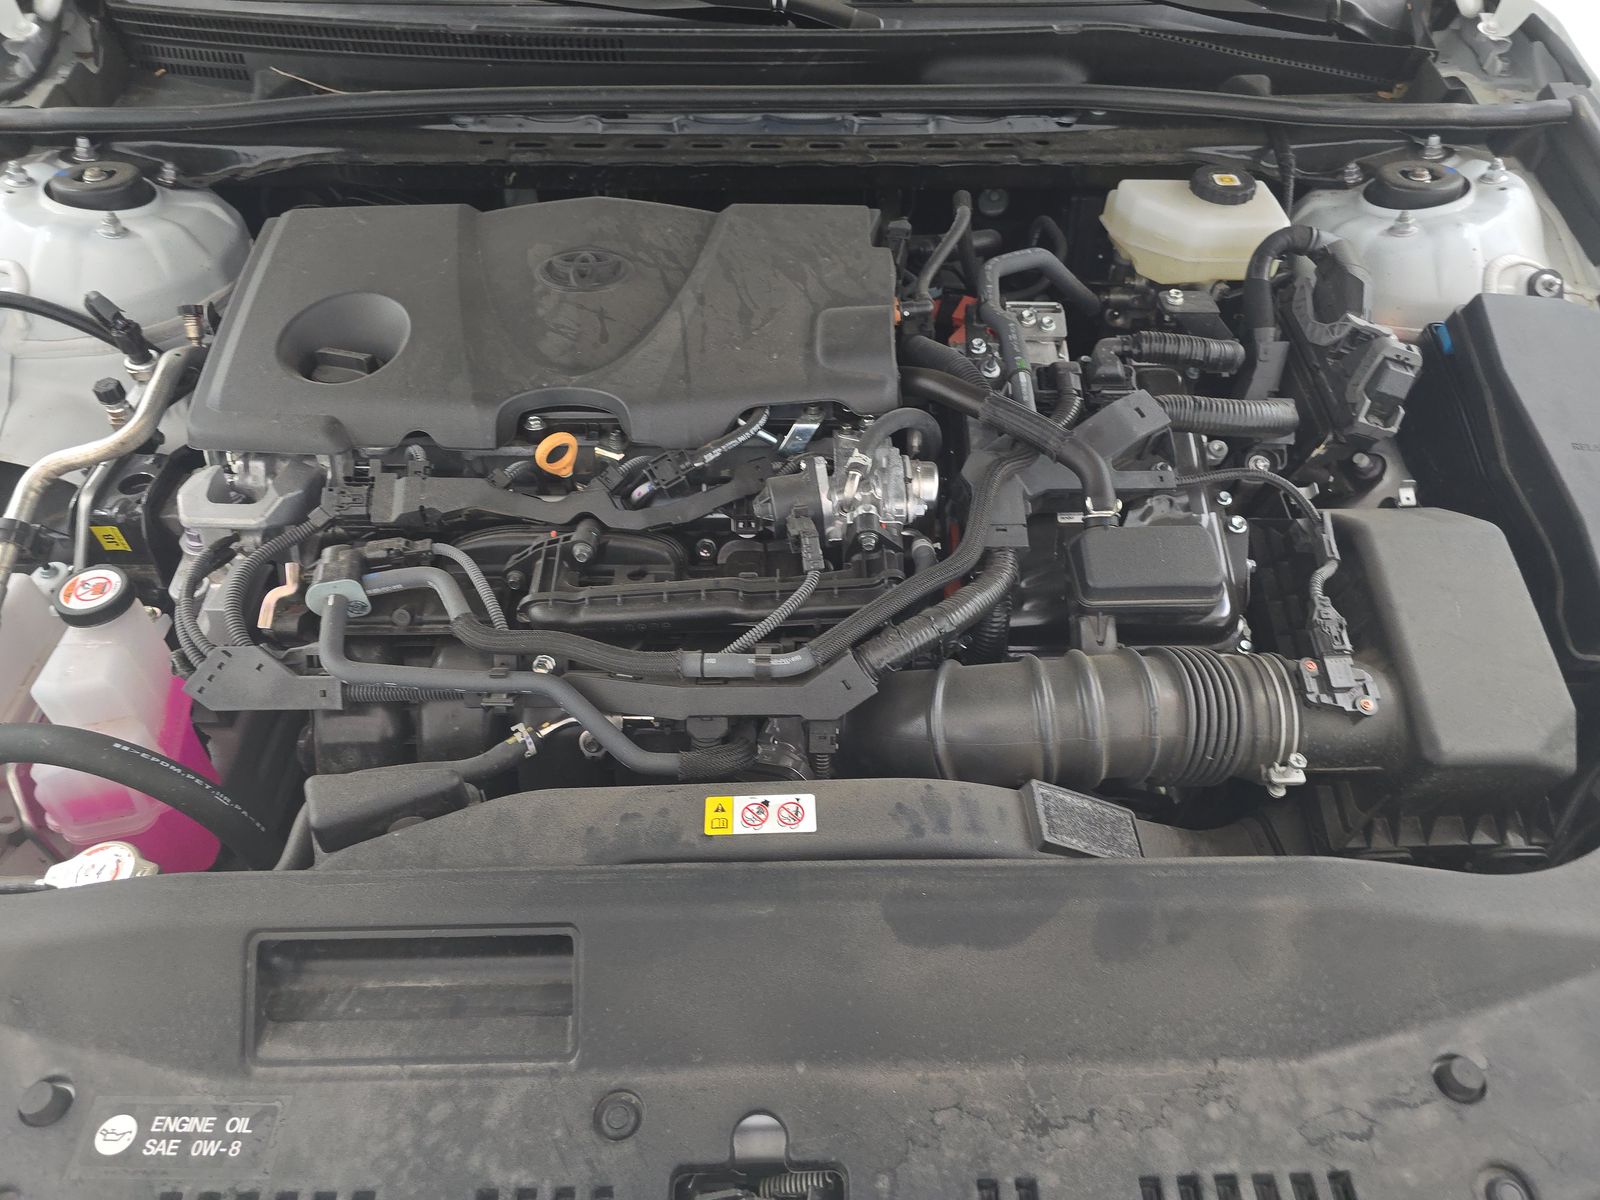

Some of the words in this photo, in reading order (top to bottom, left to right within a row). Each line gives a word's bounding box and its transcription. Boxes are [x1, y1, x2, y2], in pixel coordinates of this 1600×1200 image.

[151, 1116, 217, 1133] ENGINE
[225, 1117, 253, 1134] OIL
[142, 1139, 181, 1156] SAE
[191, 1140, 242, 1157] 0W-8
